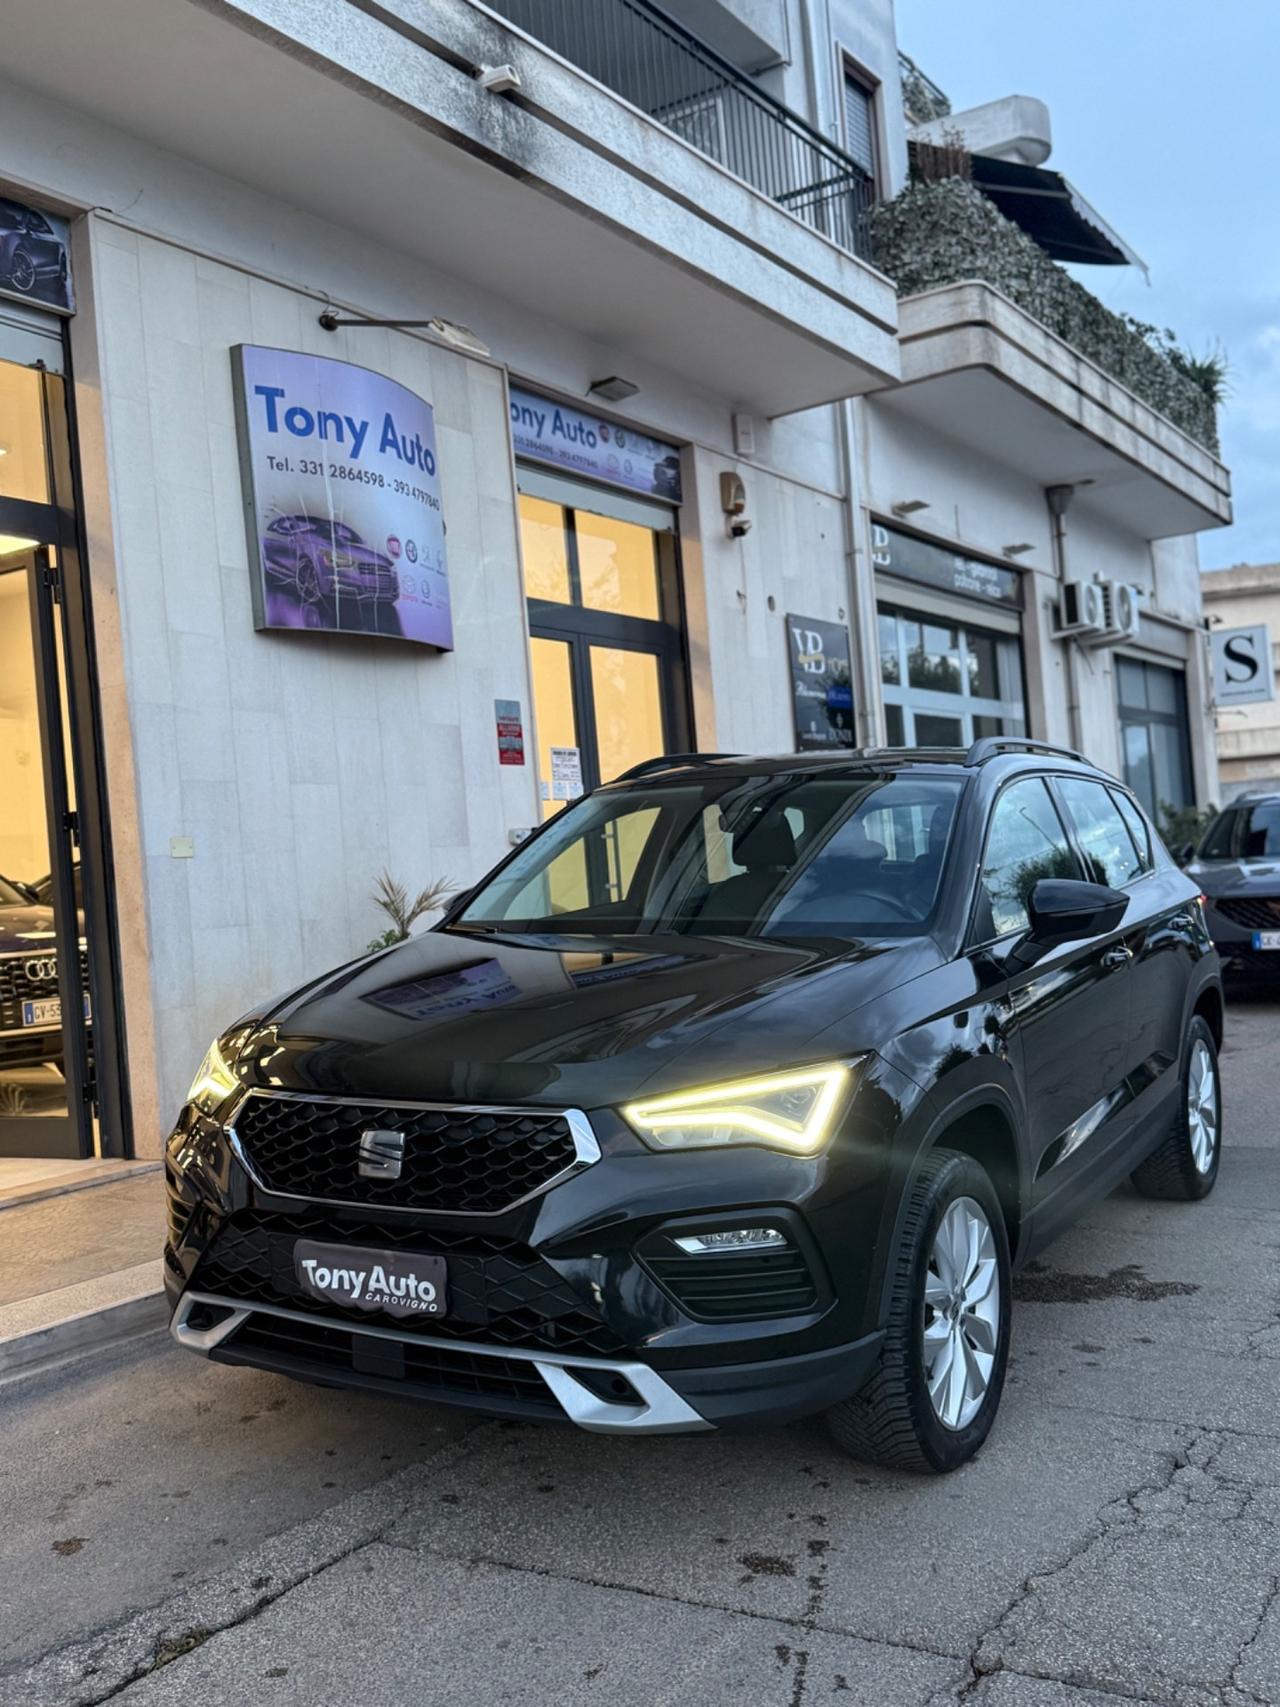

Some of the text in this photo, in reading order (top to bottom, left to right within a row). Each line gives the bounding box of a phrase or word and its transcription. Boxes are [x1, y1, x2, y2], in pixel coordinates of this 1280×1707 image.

[254, 385, 437, 478] Tony Auto
[551, 408, 598, 450] Auto
[267, 455, 295, 474] Tel.
[299, 459, 324, 477] 331
[329, 463, 385, 489] 2864598
[393, 478, 410, 497] 393
[1223, 633, 1259, 685] S
[302, 1259, 437, 1302] Tony Auto
[365, 1292, 438, 1312] CAROVIGNO
